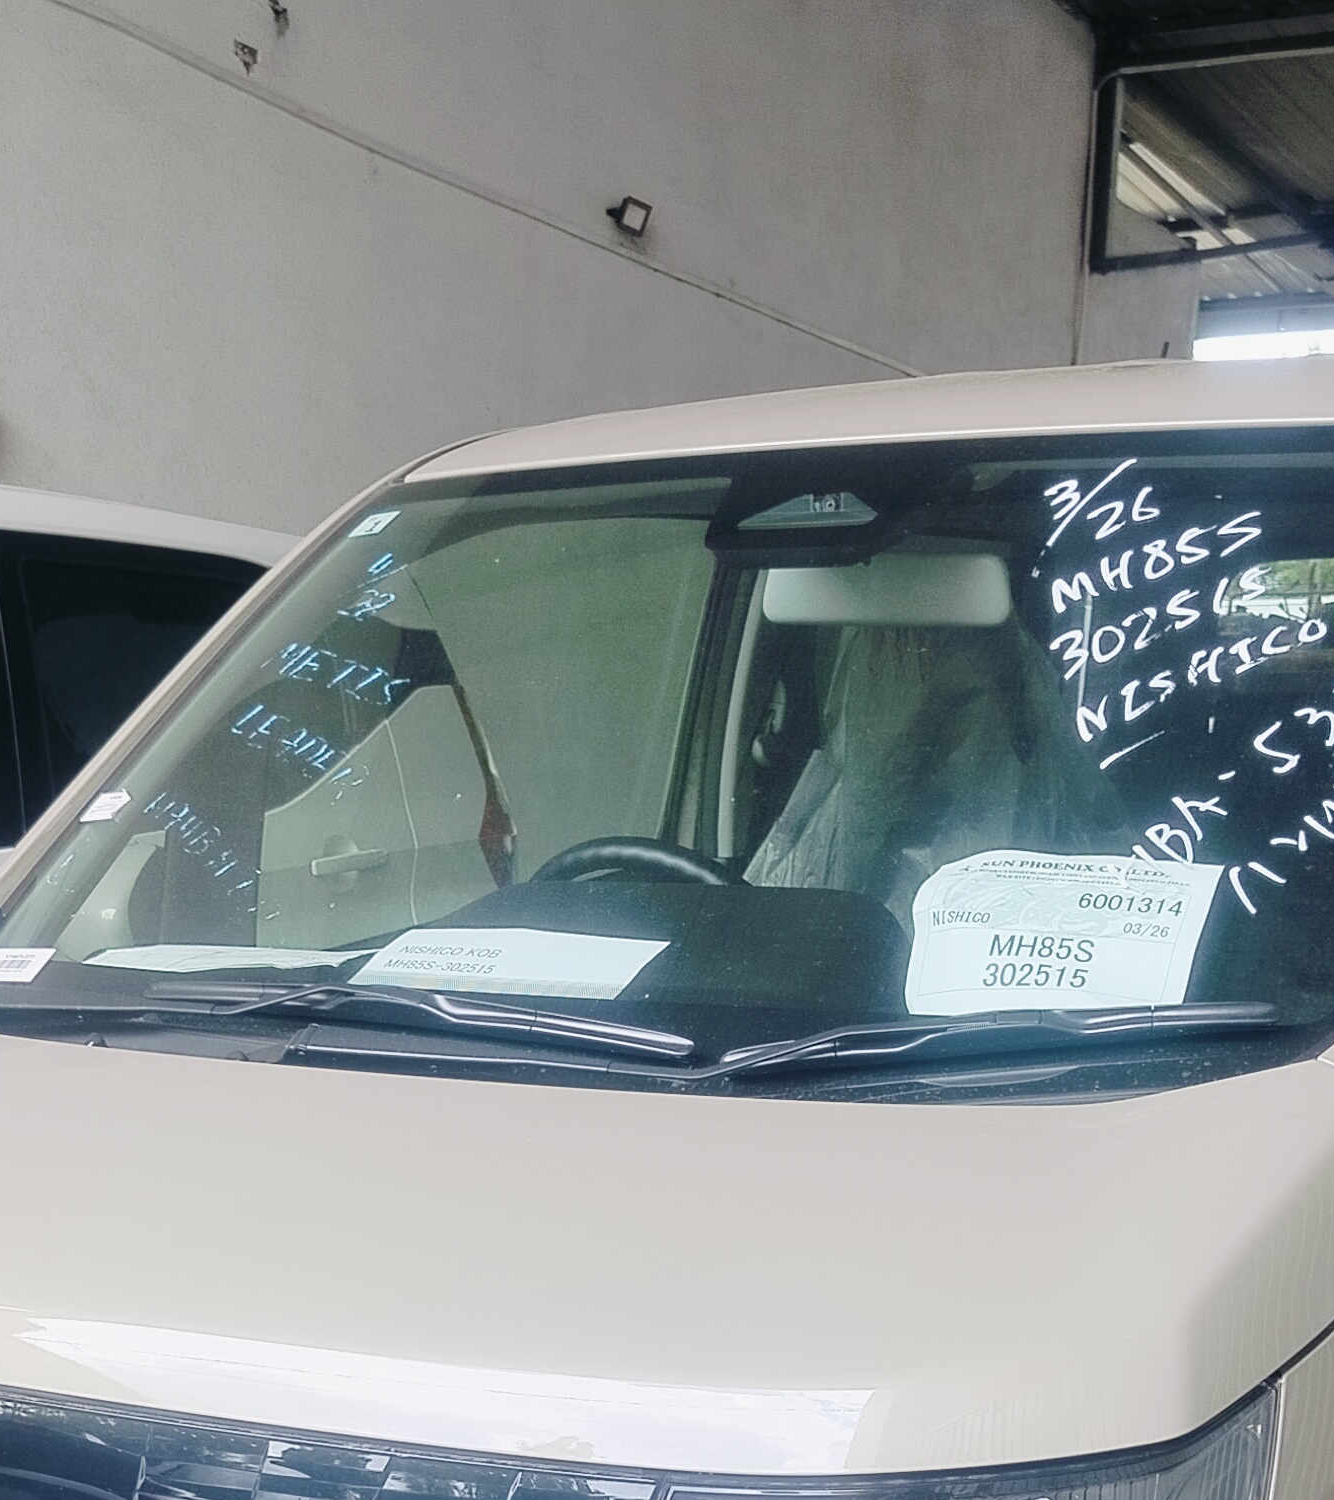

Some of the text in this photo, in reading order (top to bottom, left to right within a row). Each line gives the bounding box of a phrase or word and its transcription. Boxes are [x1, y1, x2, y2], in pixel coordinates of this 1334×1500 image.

[1043, 459, 1161, 548] 3/26
[1051, 511, 1262, 614] MH85S
[1050, 565, 1273, 680] 302515
[1076, 618, 1328, 743] NISHICO
[1019, 860, 1095, 872] PHOENIX
[1078, 893, 1184, 918] 6001314
[932, 911, 991, 926] NISHICO
[1123, 922, 1170, 939] 03/26
[399, 945, 464, 956] NISHICO
[989, 934, 1096, 964] MH85S
[383, 958, 497, 975] MH85S-302515
[982, 963, 1089, 989] 302515
